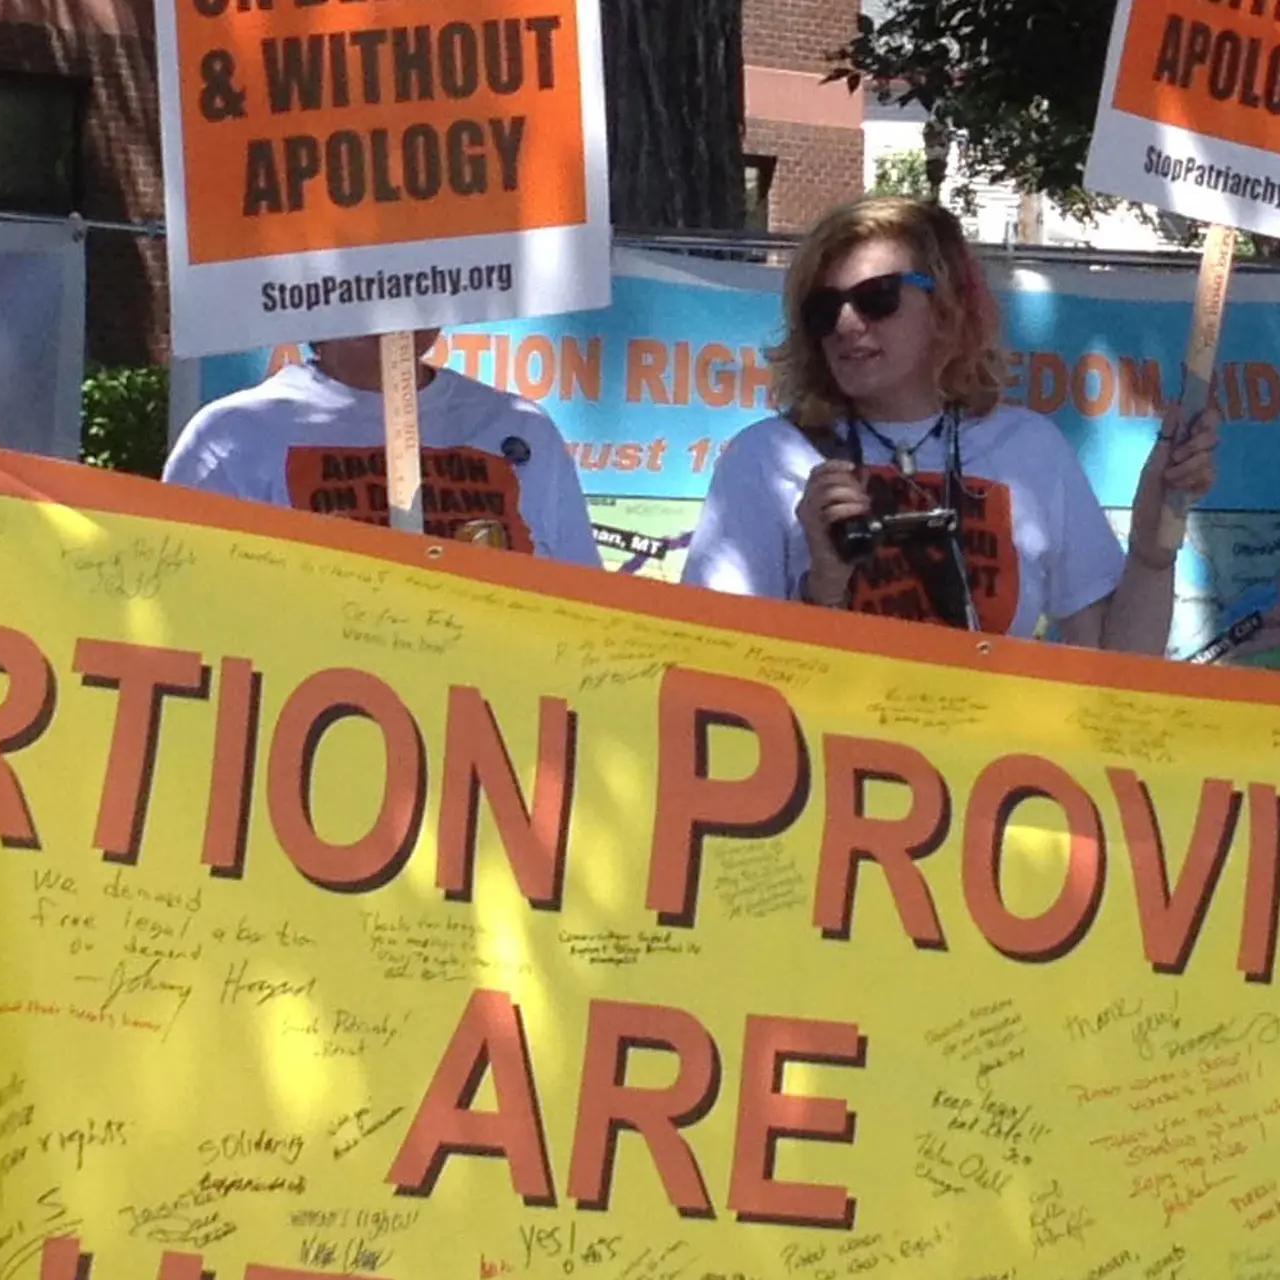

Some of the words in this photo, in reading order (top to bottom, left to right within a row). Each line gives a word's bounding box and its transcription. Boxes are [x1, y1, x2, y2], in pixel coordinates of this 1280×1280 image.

[199, 49, 247, 122] &
[261, 15, 561, 115] WITHOUT
[242, 116, 527, 218] APOLOGY
[261, 263, 513, 312] StopPatriarchy.org
[33, 868, 79, 895] We
[385, 985, 868, 1232] ARE
